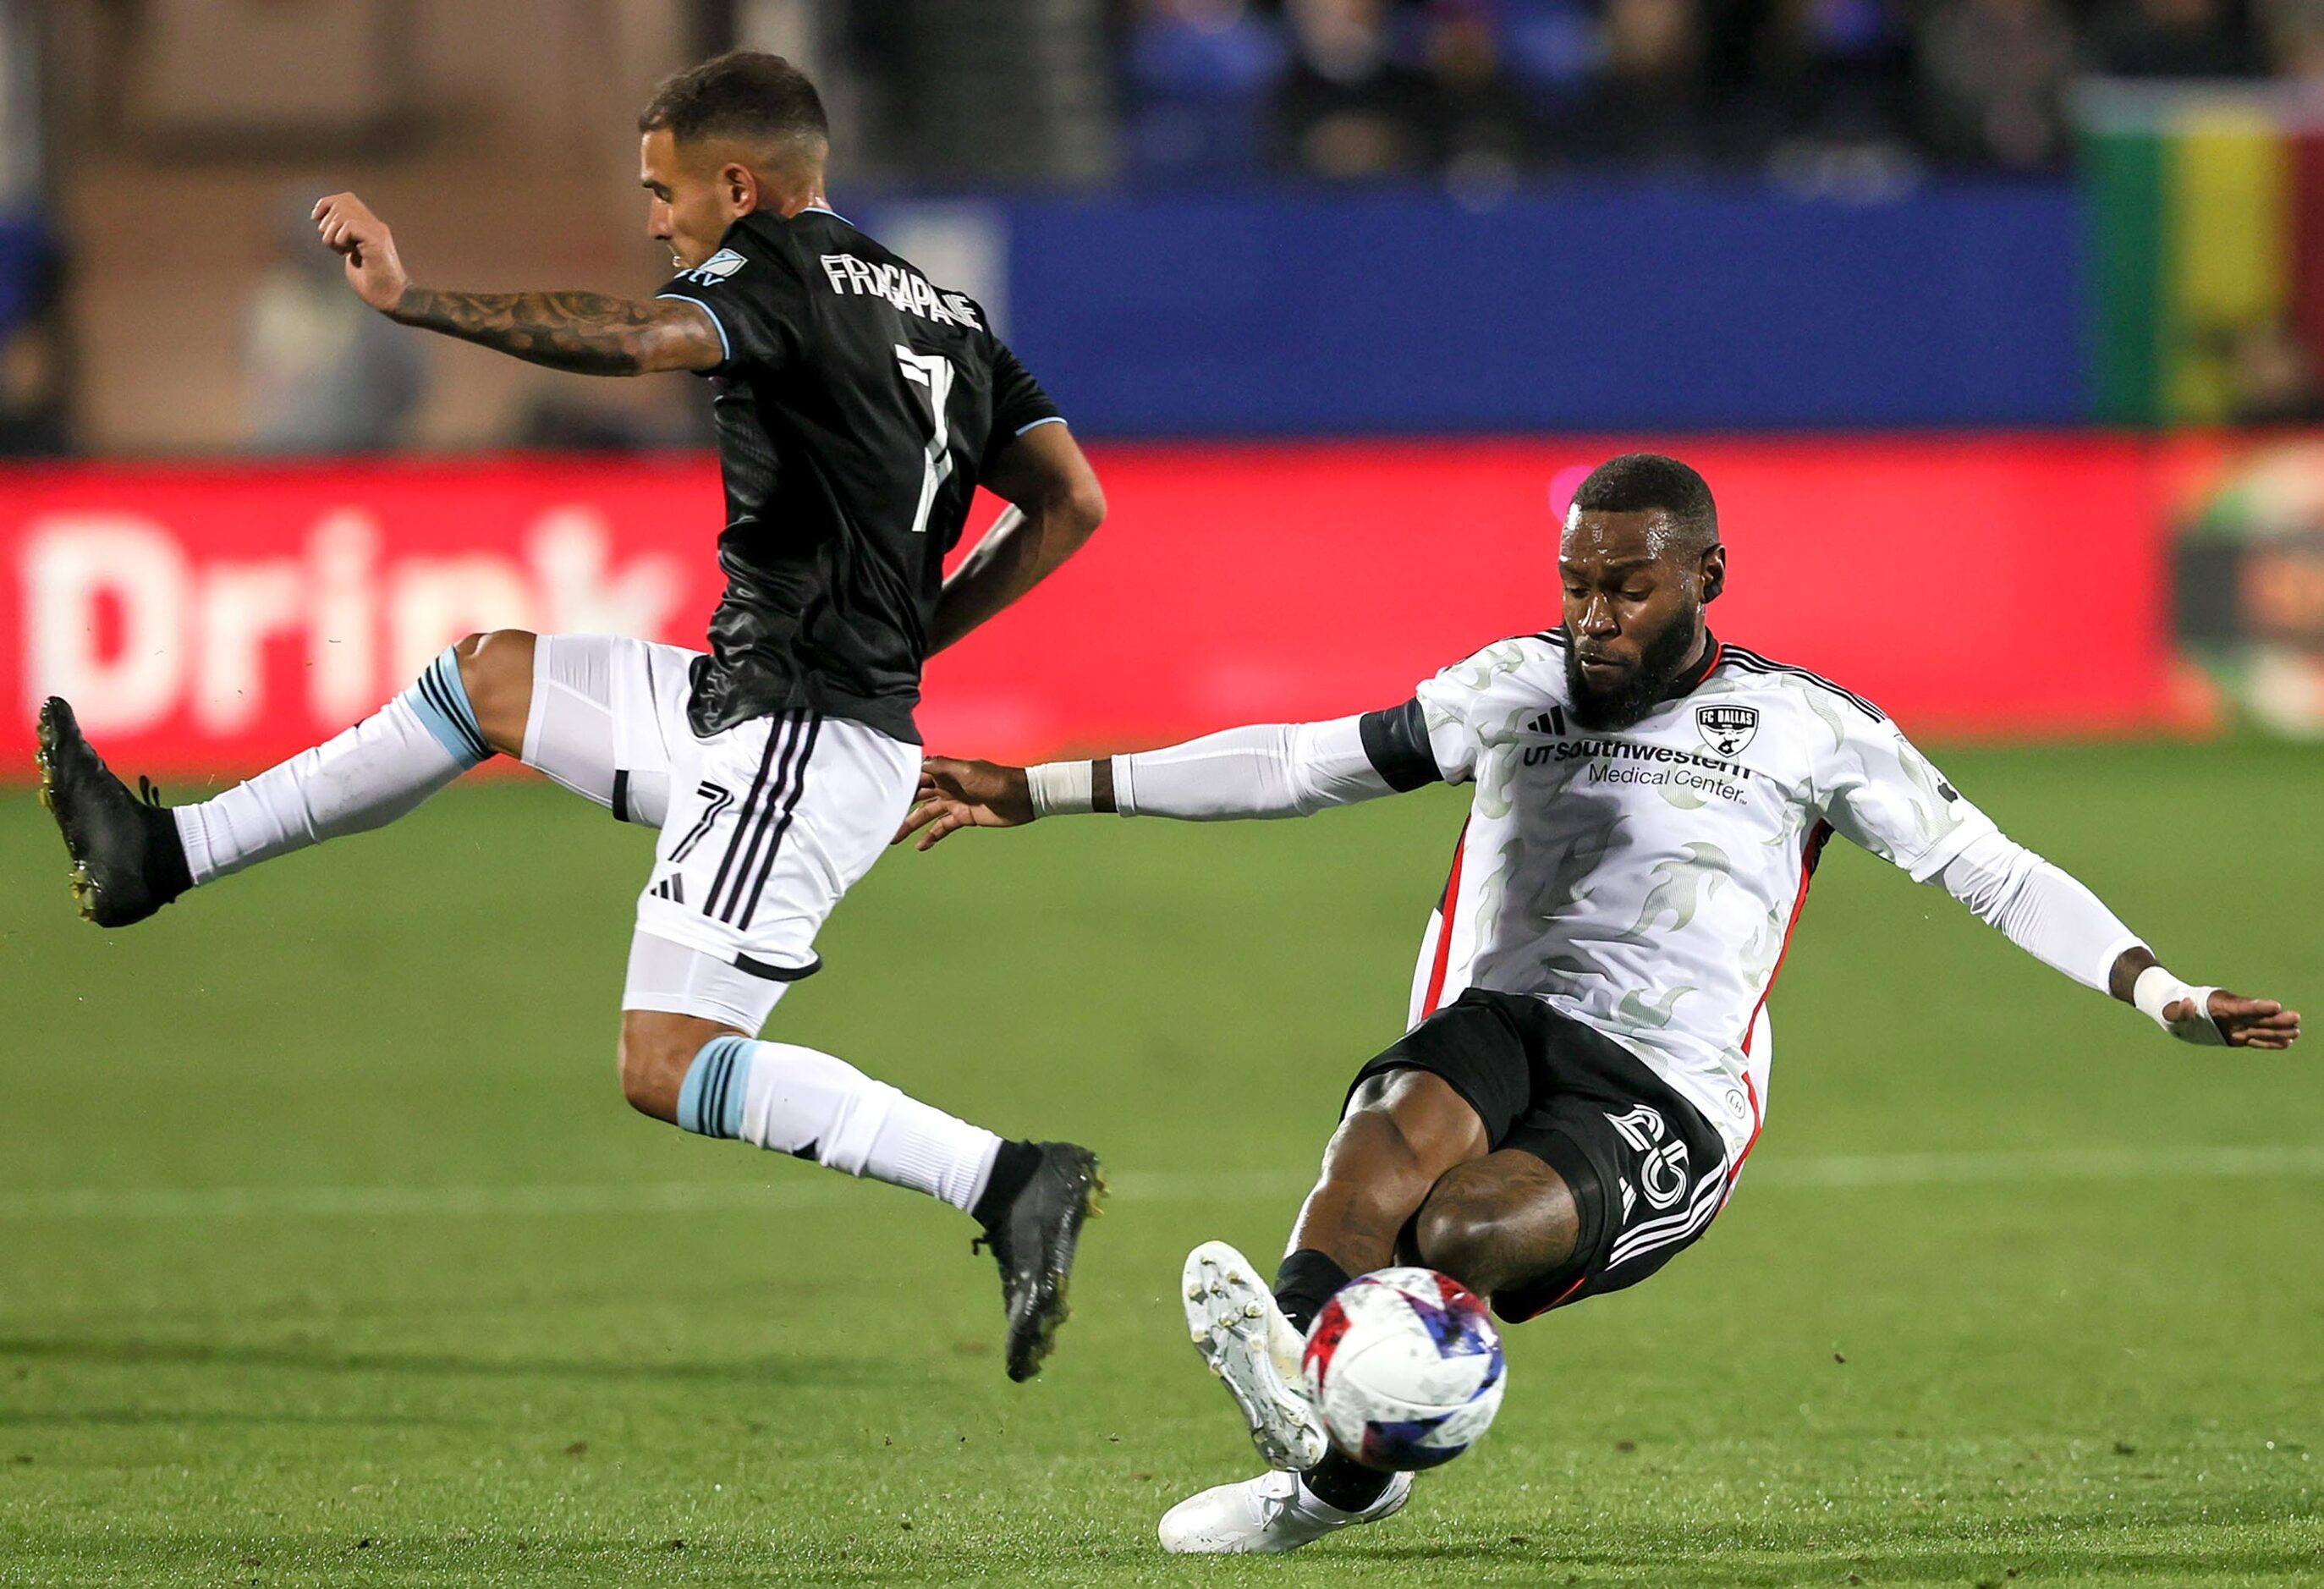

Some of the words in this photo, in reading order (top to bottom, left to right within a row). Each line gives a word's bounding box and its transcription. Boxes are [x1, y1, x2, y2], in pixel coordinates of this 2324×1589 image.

[895, 344, 954, 532] 7
[20, 508, 690, 738] Drink
[1701, 711, 1714, 723] FC
[1717, 710, 1753, 725] DALLAS
[1589, 763, 1671, 785] Medical
[667, 780, 735, 863] 7
